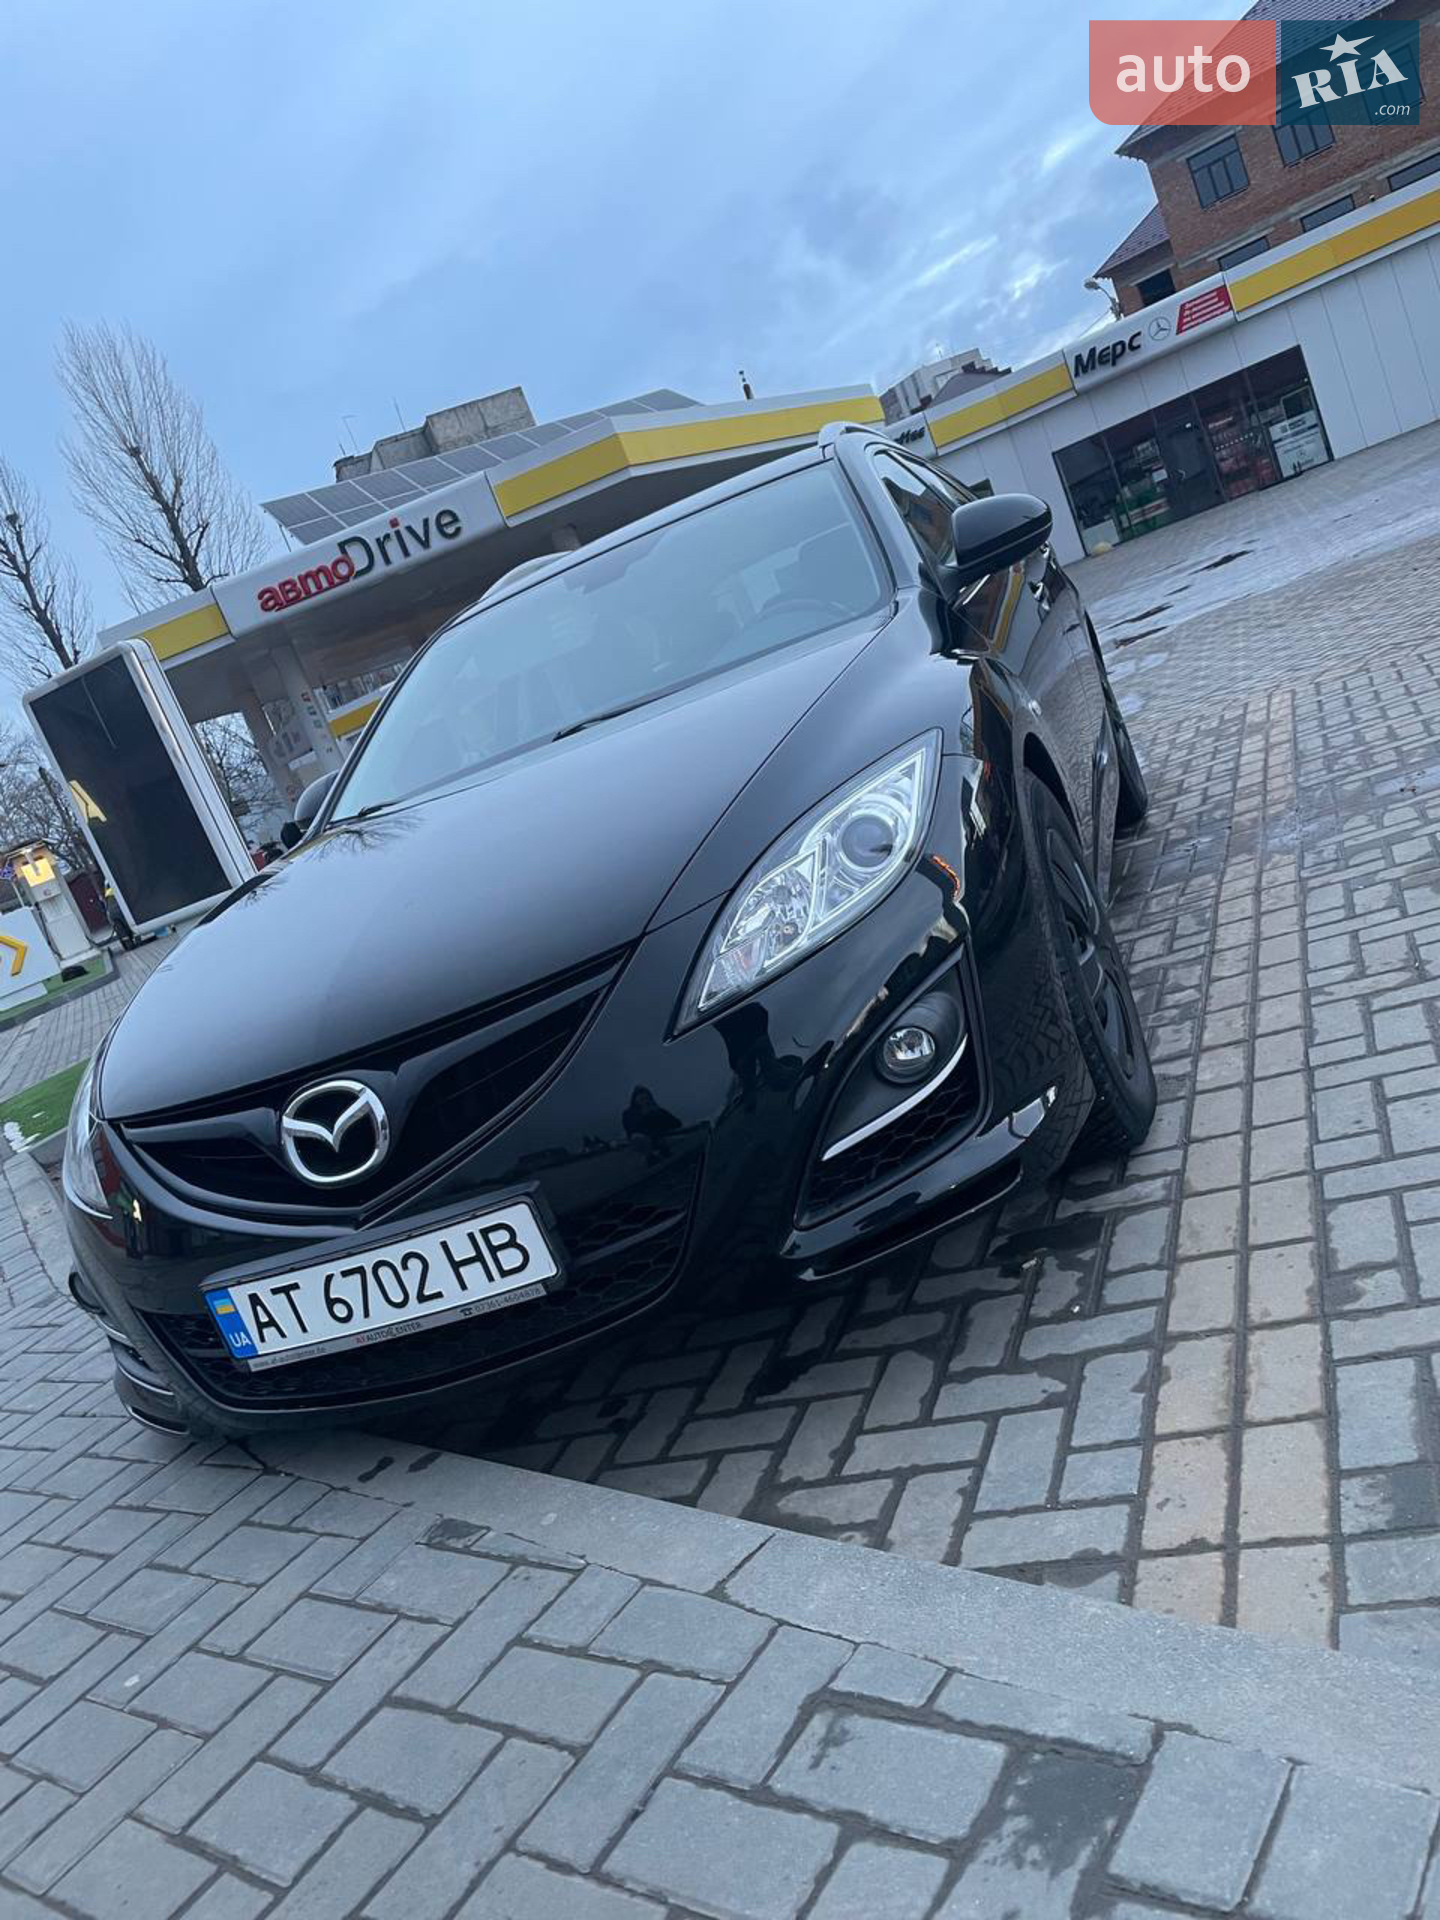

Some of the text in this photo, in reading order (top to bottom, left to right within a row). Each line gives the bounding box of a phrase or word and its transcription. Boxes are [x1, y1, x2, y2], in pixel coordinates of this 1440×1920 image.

[247, 1221, 531, 1343] AT 6702 HB
[229, 1331, 252, 1348] UA
